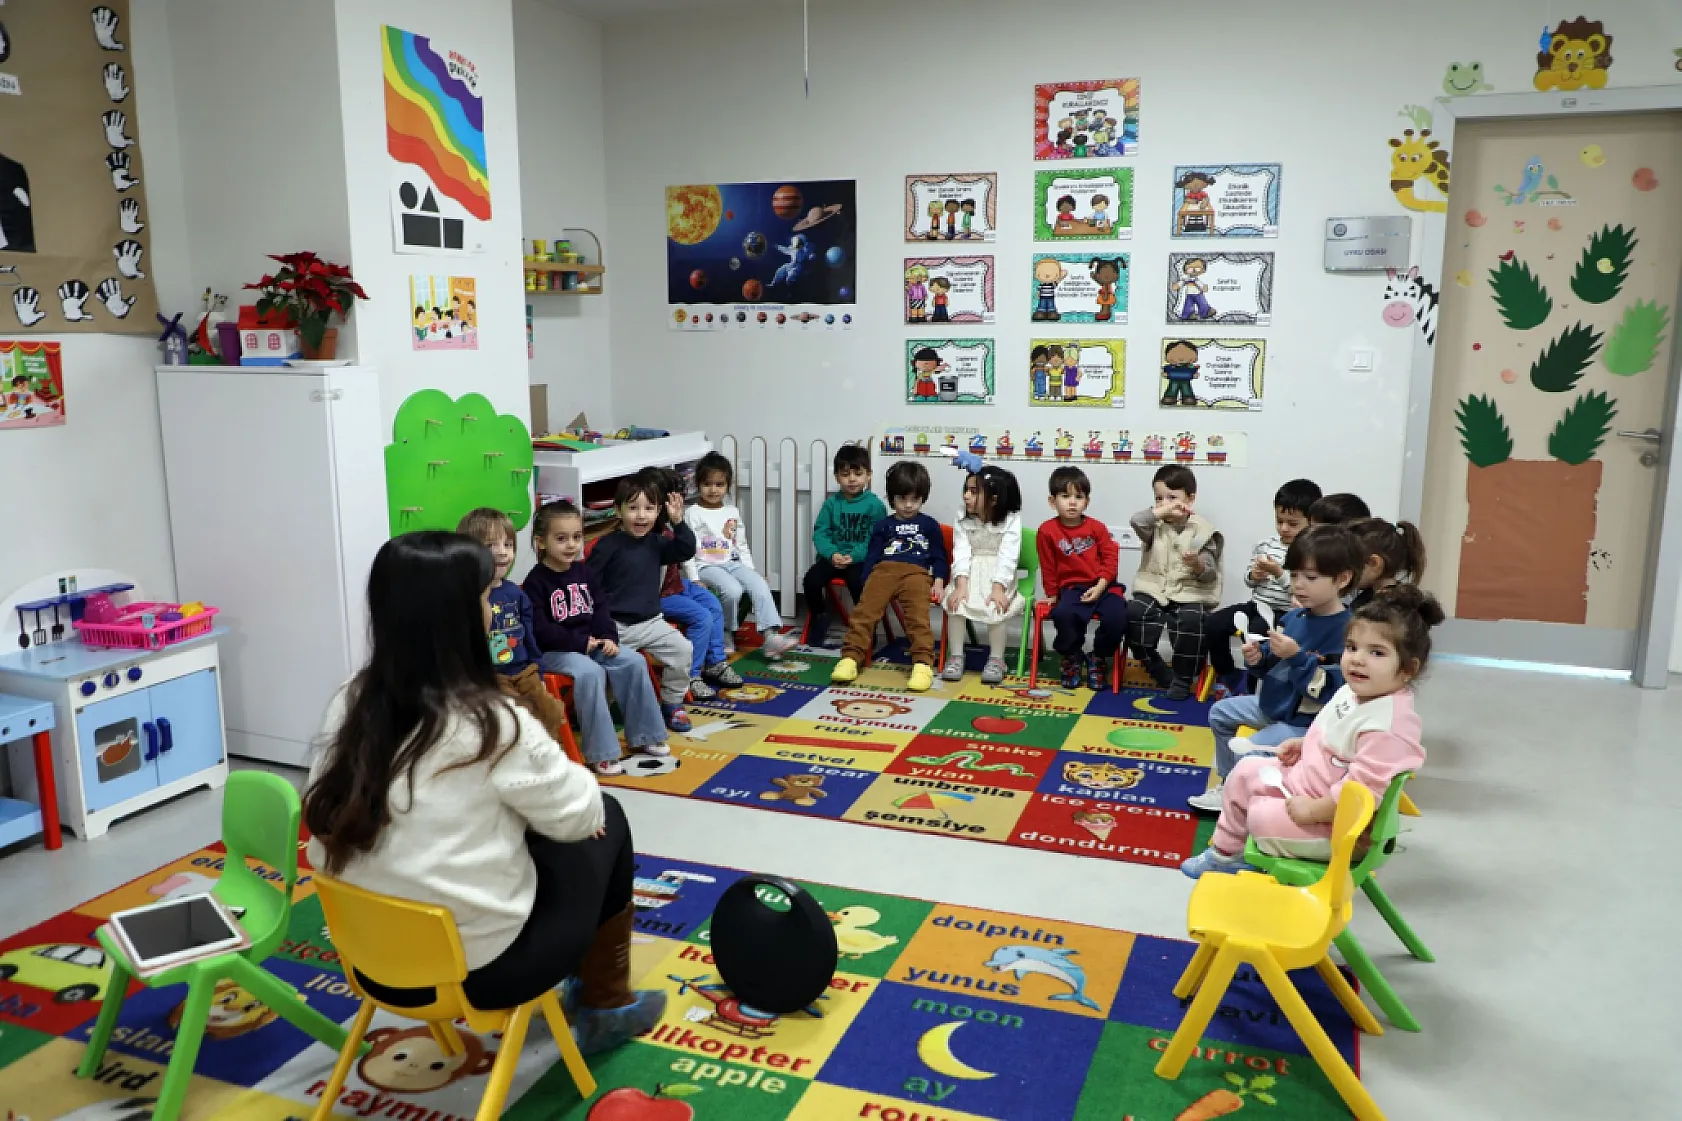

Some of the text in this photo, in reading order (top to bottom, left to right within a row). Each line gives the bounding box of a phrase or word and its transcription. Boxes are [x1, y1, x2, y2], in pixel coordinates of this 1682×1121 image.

[828, 689, 917, 704] monkey
[957, 694, 1079, 712] helikopter
[689, 708, 735, 719] bird
[1003, 707, 1069, 718] apple
[814, 725, 873, 736] ruler
[818, 715, 918, 731] maymun
[1111, 720, 1185, 732] round
[930, 728, 990, 740] elma
[680, 749, 728, 761] ball
[776, 750, 856, 766] cetvel
[966, 743, 1042, 757] snake
[1081, 745, 1197, 764] yuvarlak
[808, 765, 870, 779] bear
[907, 767, 975, 781] yılan
[1137, 762, 1202, 775] tiger
[711, 786, 751, 798] ayı
[893, 777, 1016, 798] umbrella
[1057, 784, 1156, 805] kaplan
[1041, 793, 1192, 821] ice cream
[863, 810, 987, 834] şemsiye
[1019, 830, 1182, 861] dondurma
[932, 914, 1066, 945] dolphin
[901, 965, 1022, 996] yunus
[911, 998, 1025, 1029] moon
[85, 1027, 176, 1055] slan
[637, 1023, 812, 1072] likopter
[72, 1061, 161, 1091] ird
[669, 1056, 788, 1095] apple
[903, 1075, 957, 1101] ay
